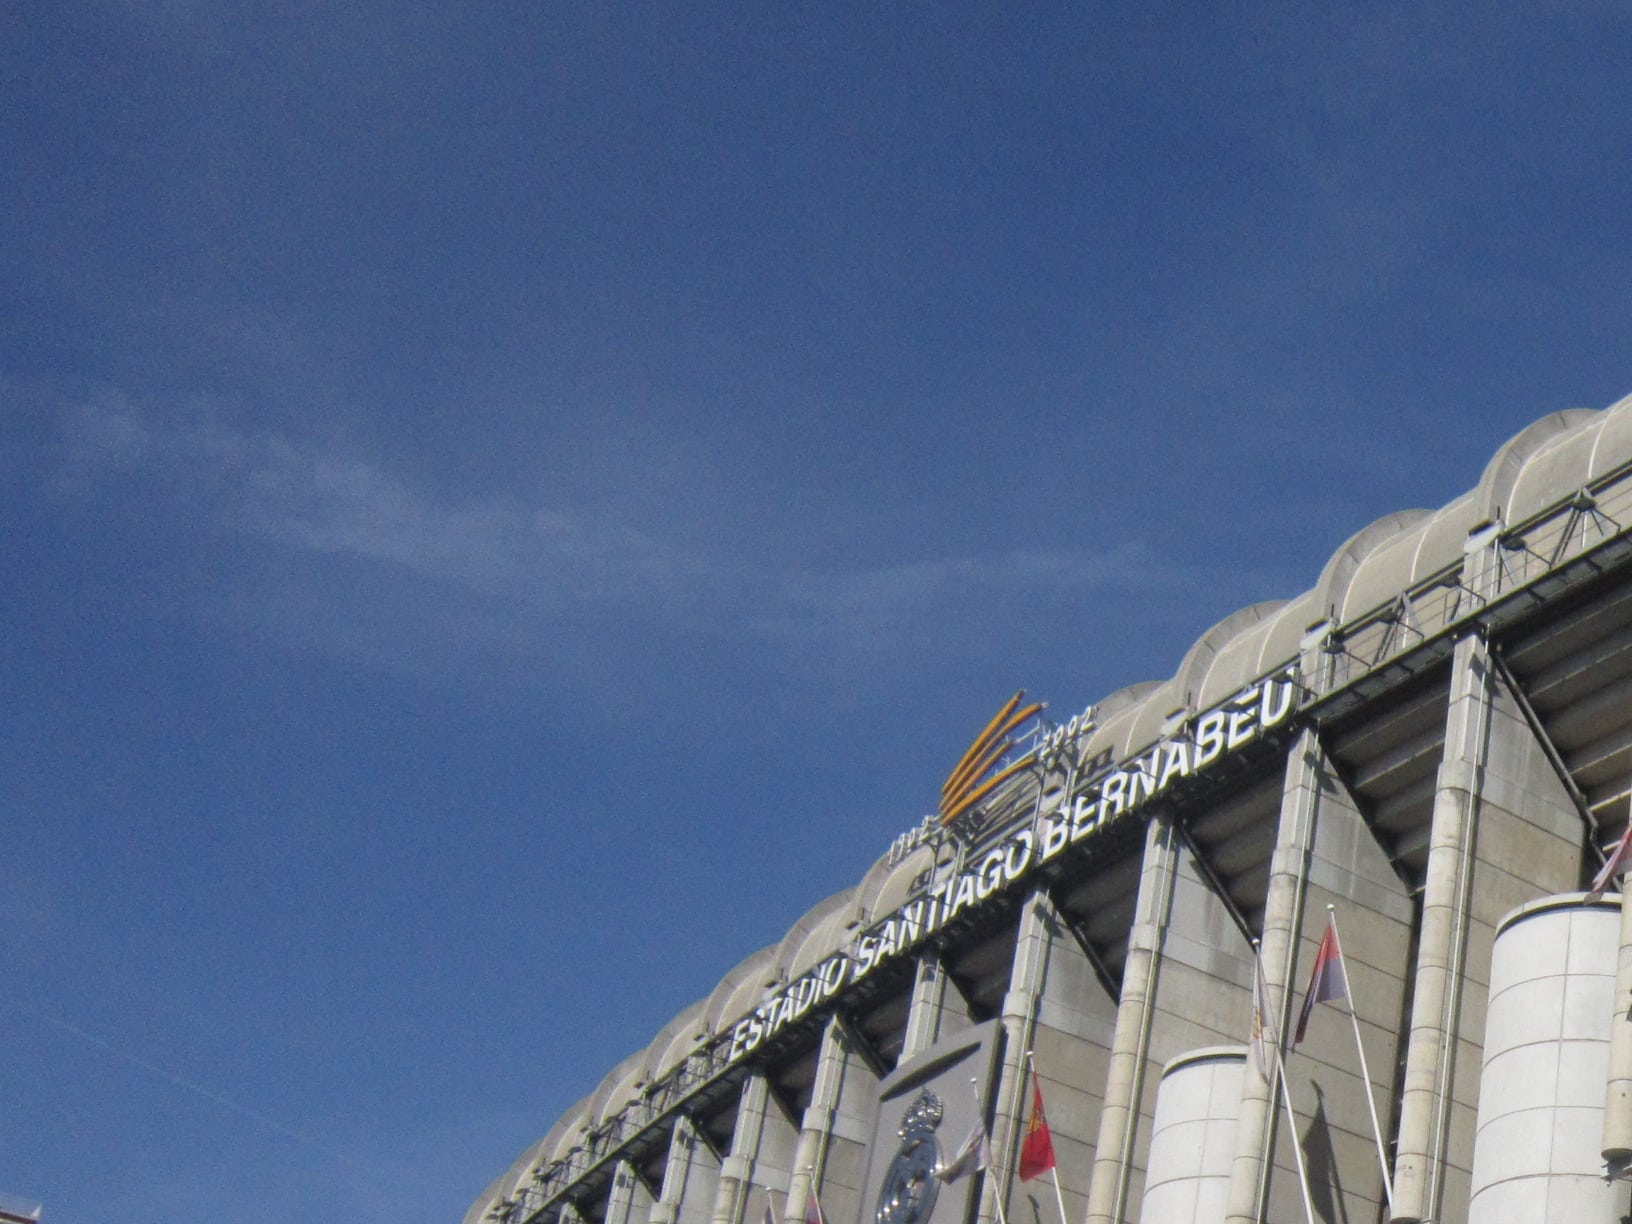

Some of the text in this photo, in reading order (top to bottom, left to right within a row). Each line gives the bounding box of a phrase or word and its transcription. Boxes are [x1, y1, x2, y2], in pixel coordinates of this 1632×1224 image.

[1041, 705, 1096, 758] 2002
[729, 666, 1296, 1063] ESTADIO SANTIAGO BERNABEU
